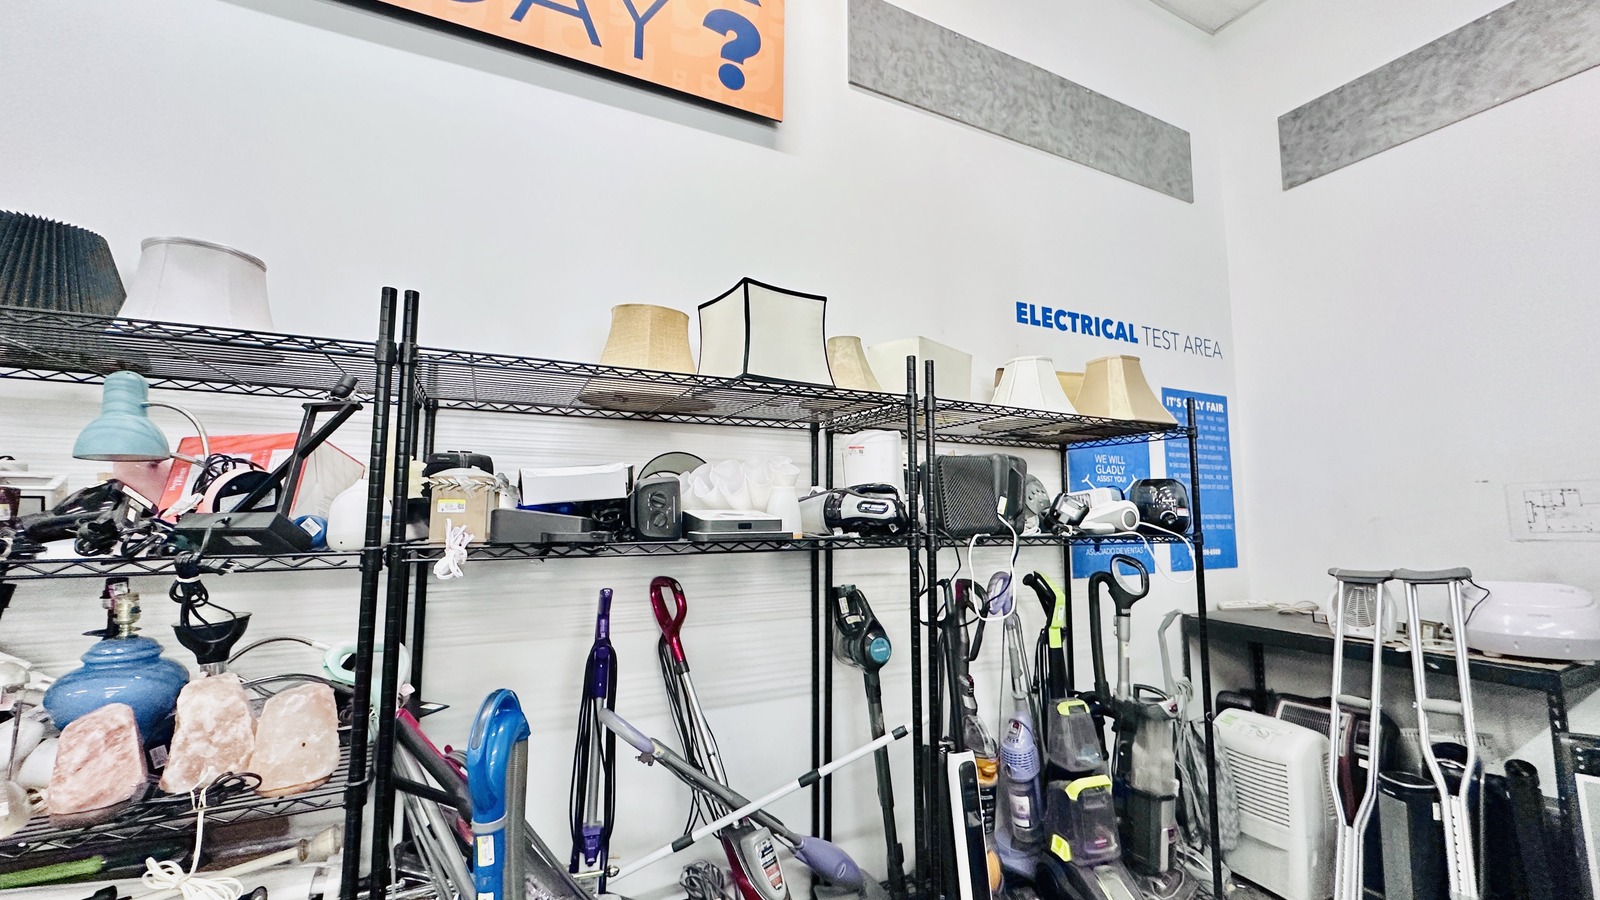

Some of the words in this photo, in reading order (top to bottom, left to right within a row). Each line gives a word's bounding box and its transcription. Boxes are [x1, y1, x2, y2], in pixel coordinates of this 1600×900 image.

[1016, 301, 1139, 344] ELECTRICAL
[1141, 326, 1180, 351] TEST
[1183, 335, 1224, 360] AREA
[1166, 396, 1181, 407] IT'S
[1183, 398, 1204, 410] OLY
[1206, 402, 1224, 413] FAIR
[1094, 454, 1107, 463] WE
[1108, 455, 1125, 464] WILL
[1095, 465, 1125, 475] GLADLY
